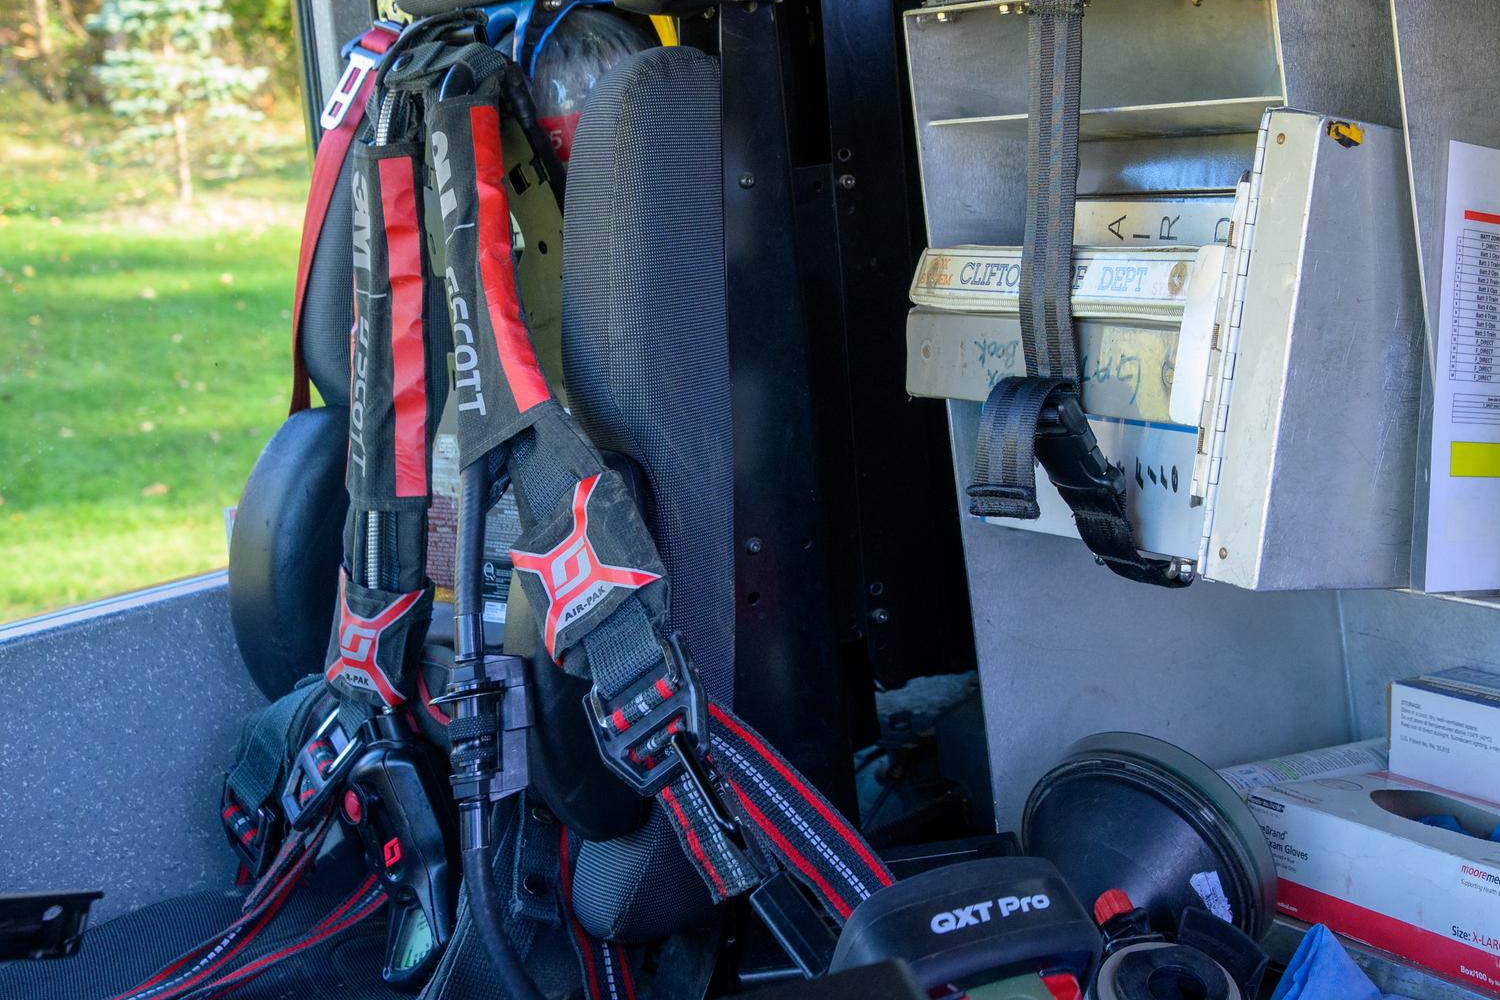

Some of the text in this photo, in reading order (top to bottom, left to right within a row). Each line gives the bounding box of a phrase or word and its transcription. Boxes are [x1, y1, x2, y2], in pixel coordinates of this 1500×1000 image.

[959, 261, 1021, 287] CLIFTO
[1098, 266, 1149, 292] DEPT
[448, 295, 486, 416] SCOTT
[564, 585, 606, 622] AIR-PAK
[1285, 844, 1308, 861] Gloves
[930, 893, 1050, 934] QXT Pro
[1451, 925, 1471, 942] Size:
[1460, 966, 1487, 983] Box/100
